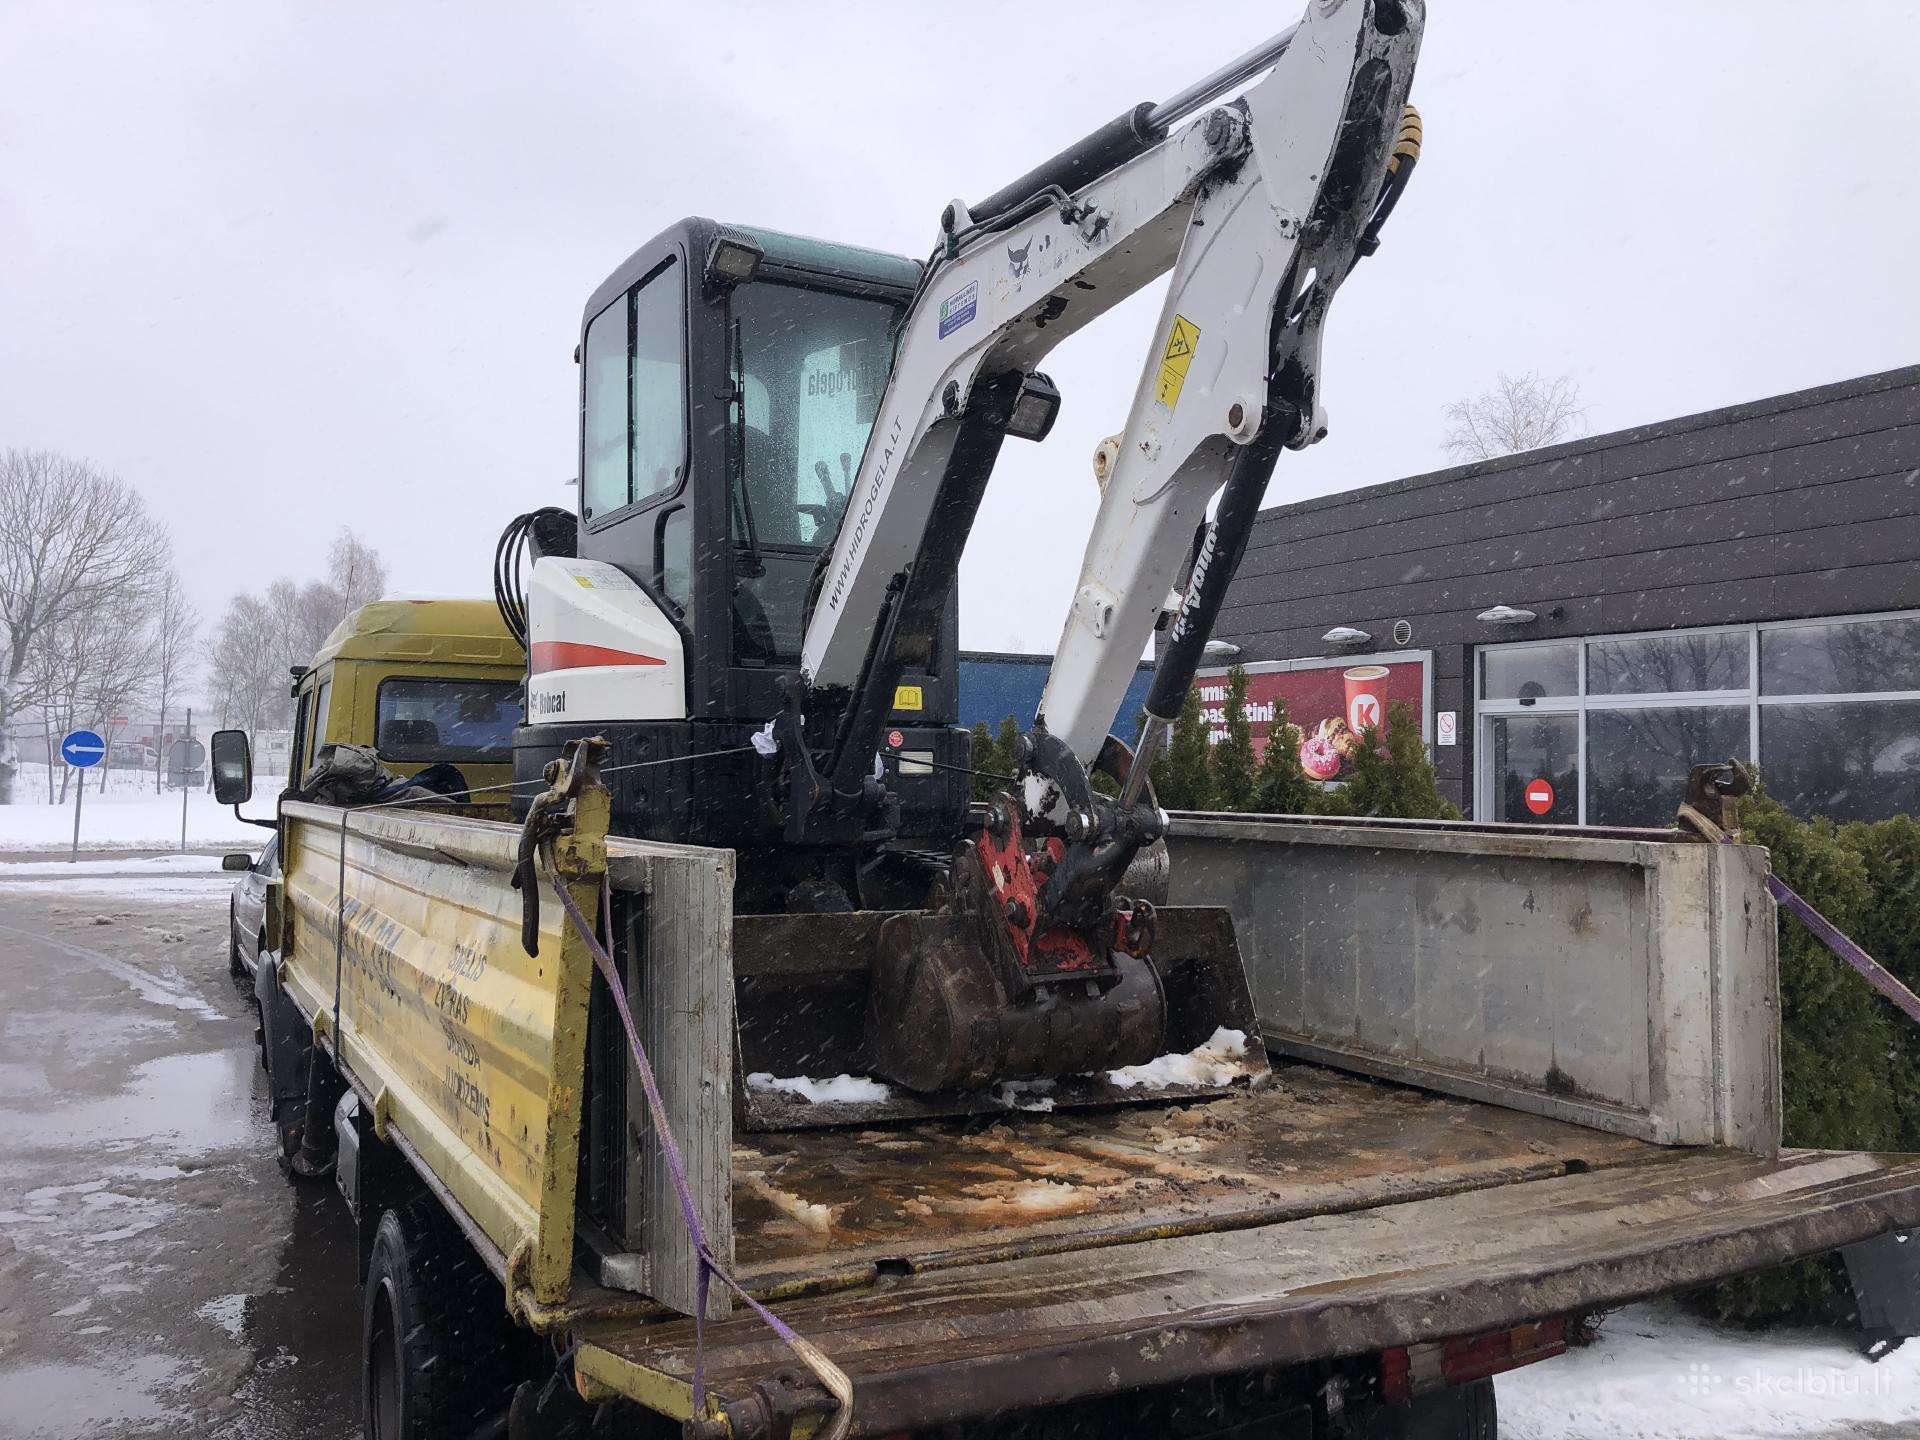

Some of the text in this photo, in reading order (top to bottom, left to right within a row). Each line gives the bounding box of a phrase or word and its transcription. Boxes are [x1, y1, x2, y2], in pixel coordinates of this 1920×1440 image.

[829, 415, 903, 611] WWW.HIDROGELA.LT
[539, 690, 566, 715] Bobcat
[1357, 703, 1376, 728] K
